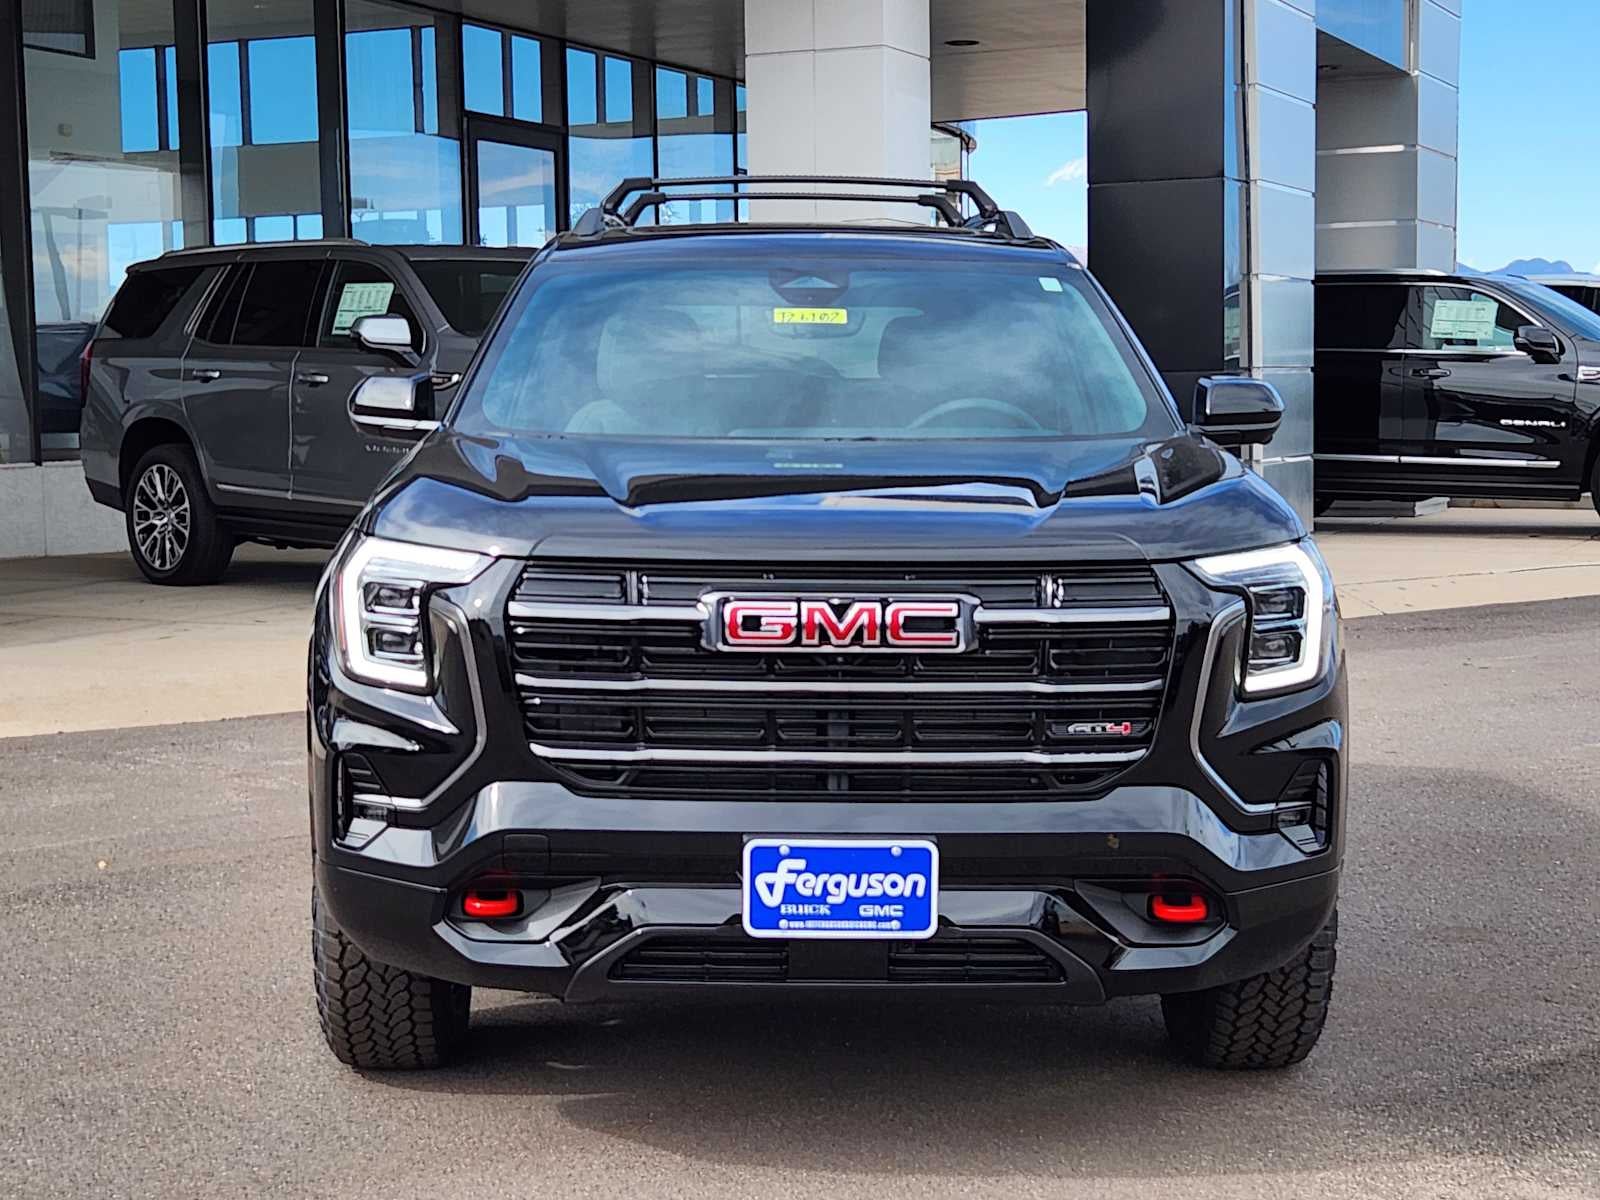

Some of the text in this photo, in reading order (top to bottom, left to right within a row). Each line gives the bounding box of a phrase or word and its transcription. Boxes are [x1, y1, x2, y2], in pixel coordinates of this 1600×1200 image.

[723, 601, 958, 645] GMC
[755, 859, 926, 907] Ferguson
[780, 904, 904, 917] BUICK GMC
